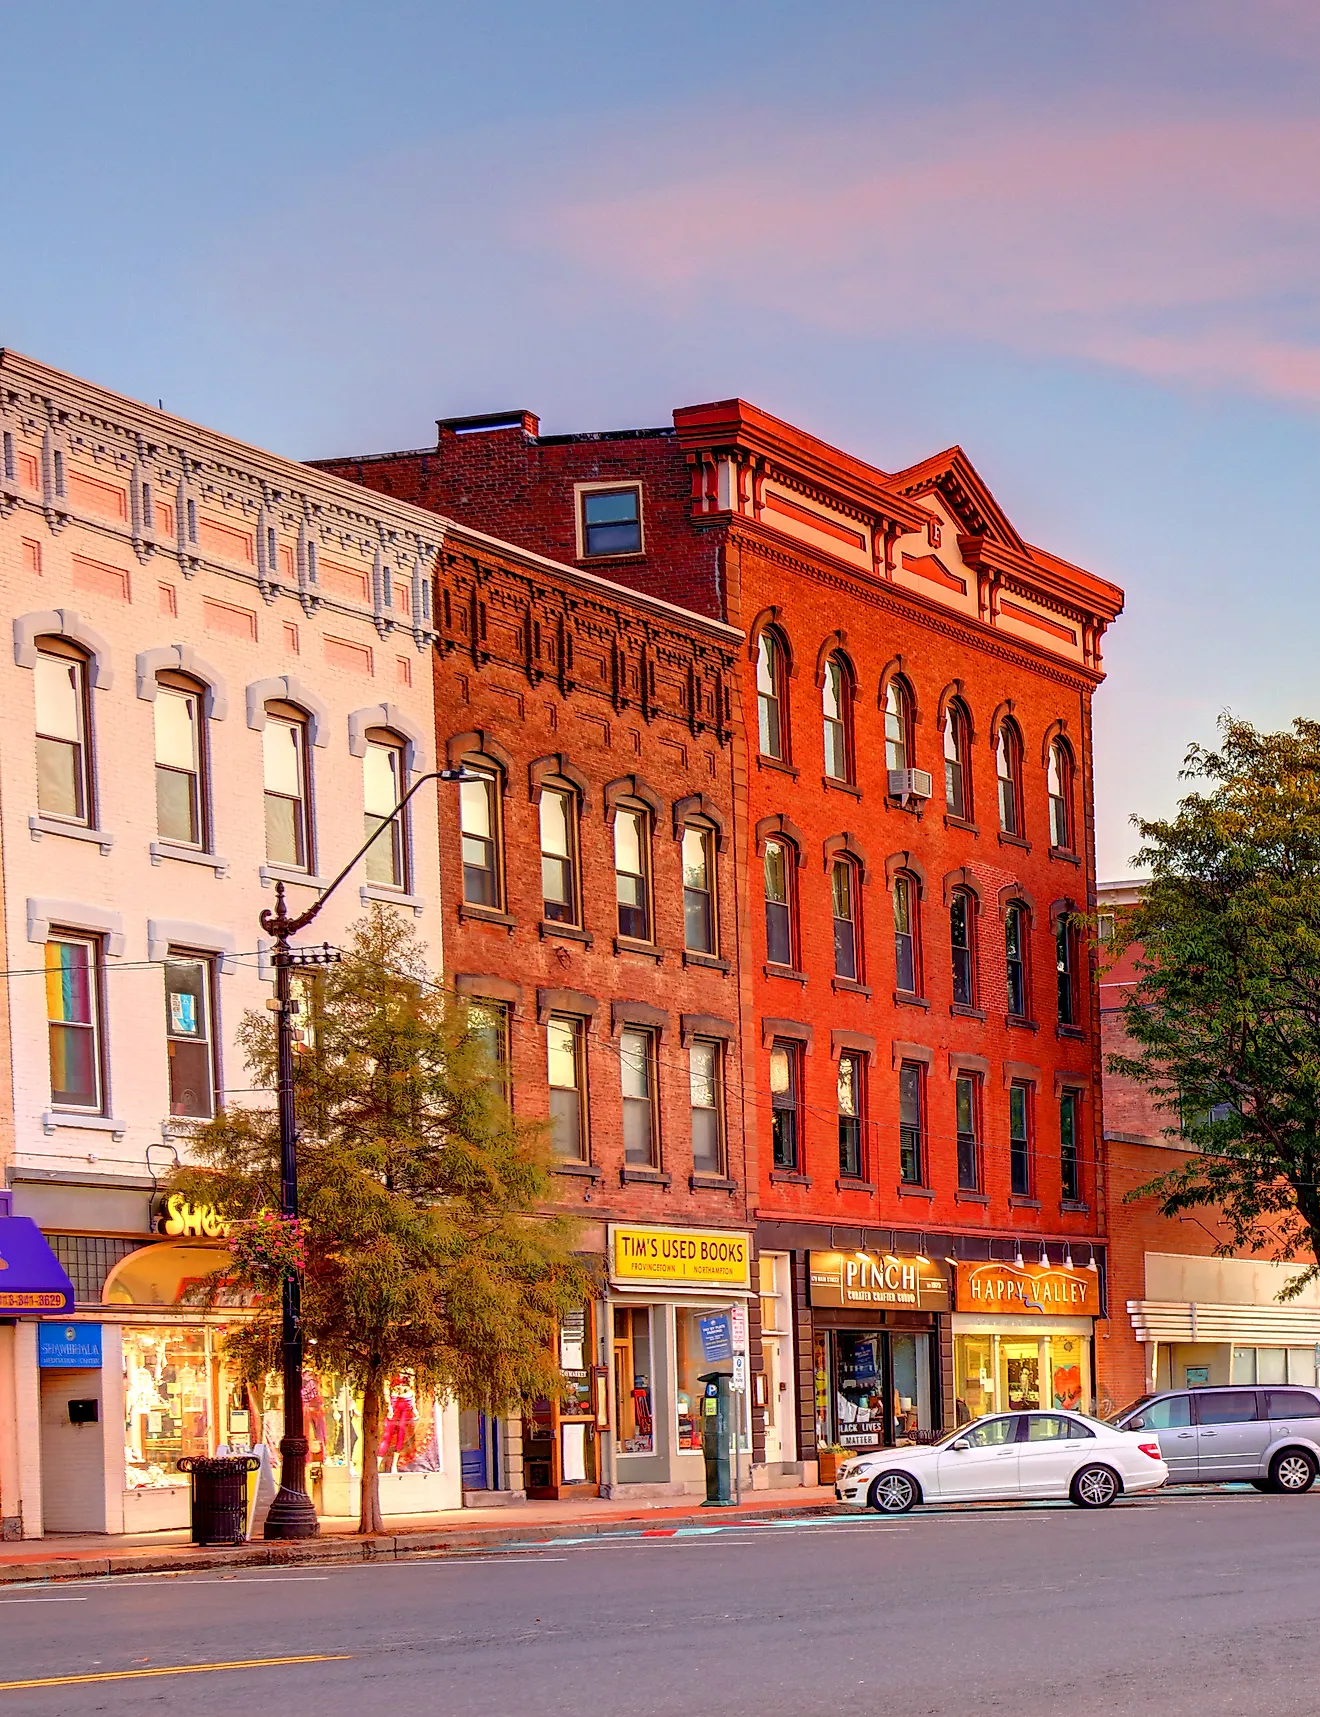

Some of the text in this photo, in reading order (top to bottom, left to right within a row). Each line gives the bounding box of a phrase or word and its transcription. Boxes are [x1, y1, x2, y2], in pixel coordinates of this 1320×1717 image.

[621, 1236, 743, 1262] TIM'S USED BOOKS
[631, 1262, 733, 1275] PROVINCETOWN NORTHAMPTON
[846, 1260, 915, 1290] PINCH
[971, 1279, 1087, 1302] HAPPY VALLEY
[862, 1422, 882, 1432] LIVES
[845, 1435, 873, 1444] MATTER
